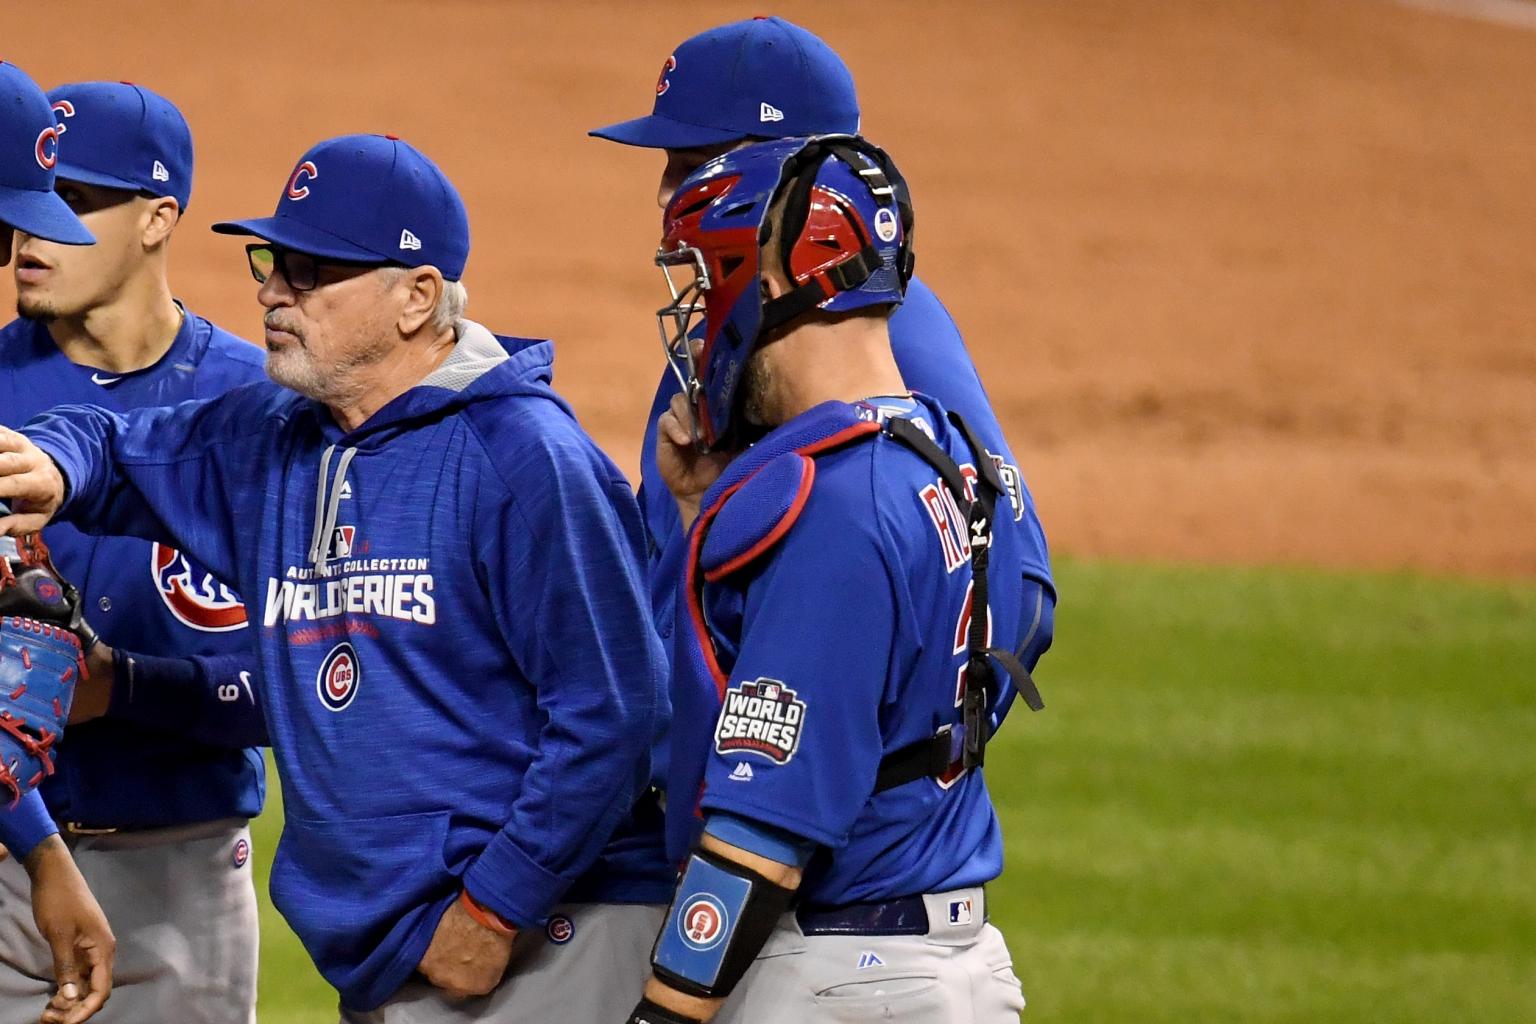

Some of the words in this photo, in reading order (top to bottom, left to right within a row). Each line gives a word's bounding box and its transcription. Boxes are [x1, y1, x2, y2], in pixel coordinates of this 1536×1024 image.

[35, 126, 58, 171] C
[287, 160, 318, 201] C
[344, 558, 427, 573] COLLECTION
[729, 693, 801, 726] WORLD
[720, 714, 796, 751] SERIES
